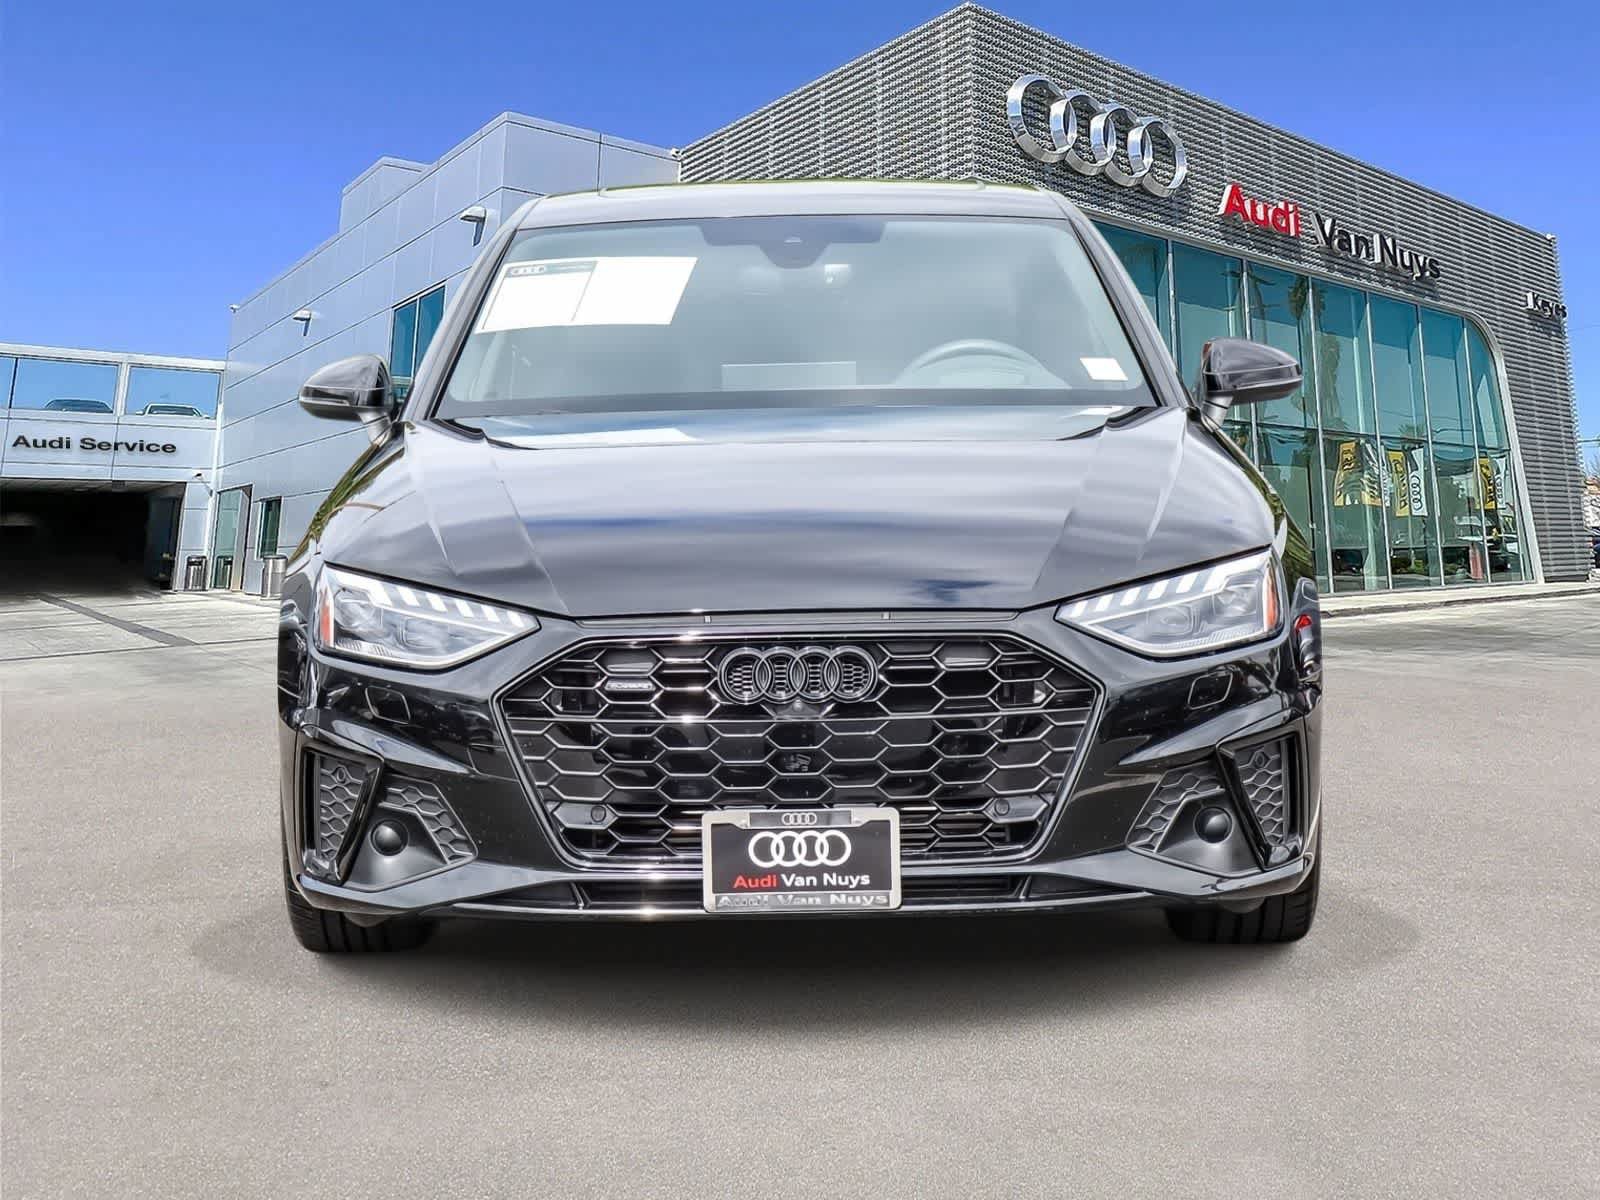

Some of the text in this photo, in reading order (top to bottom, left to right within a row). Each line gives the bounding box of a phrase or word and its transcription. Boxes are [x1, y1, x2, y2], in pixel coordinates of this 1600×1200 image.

[1218, 183, 1441, 281] Audi Van Nuys
[1526, 292, 1567, 319] Keyes
[12, 435, 177, 453] Audi Service
[733, 873, 870, 888] Audi Van Nuys
[717, 894, 888, 907] Audi Van Nuys
